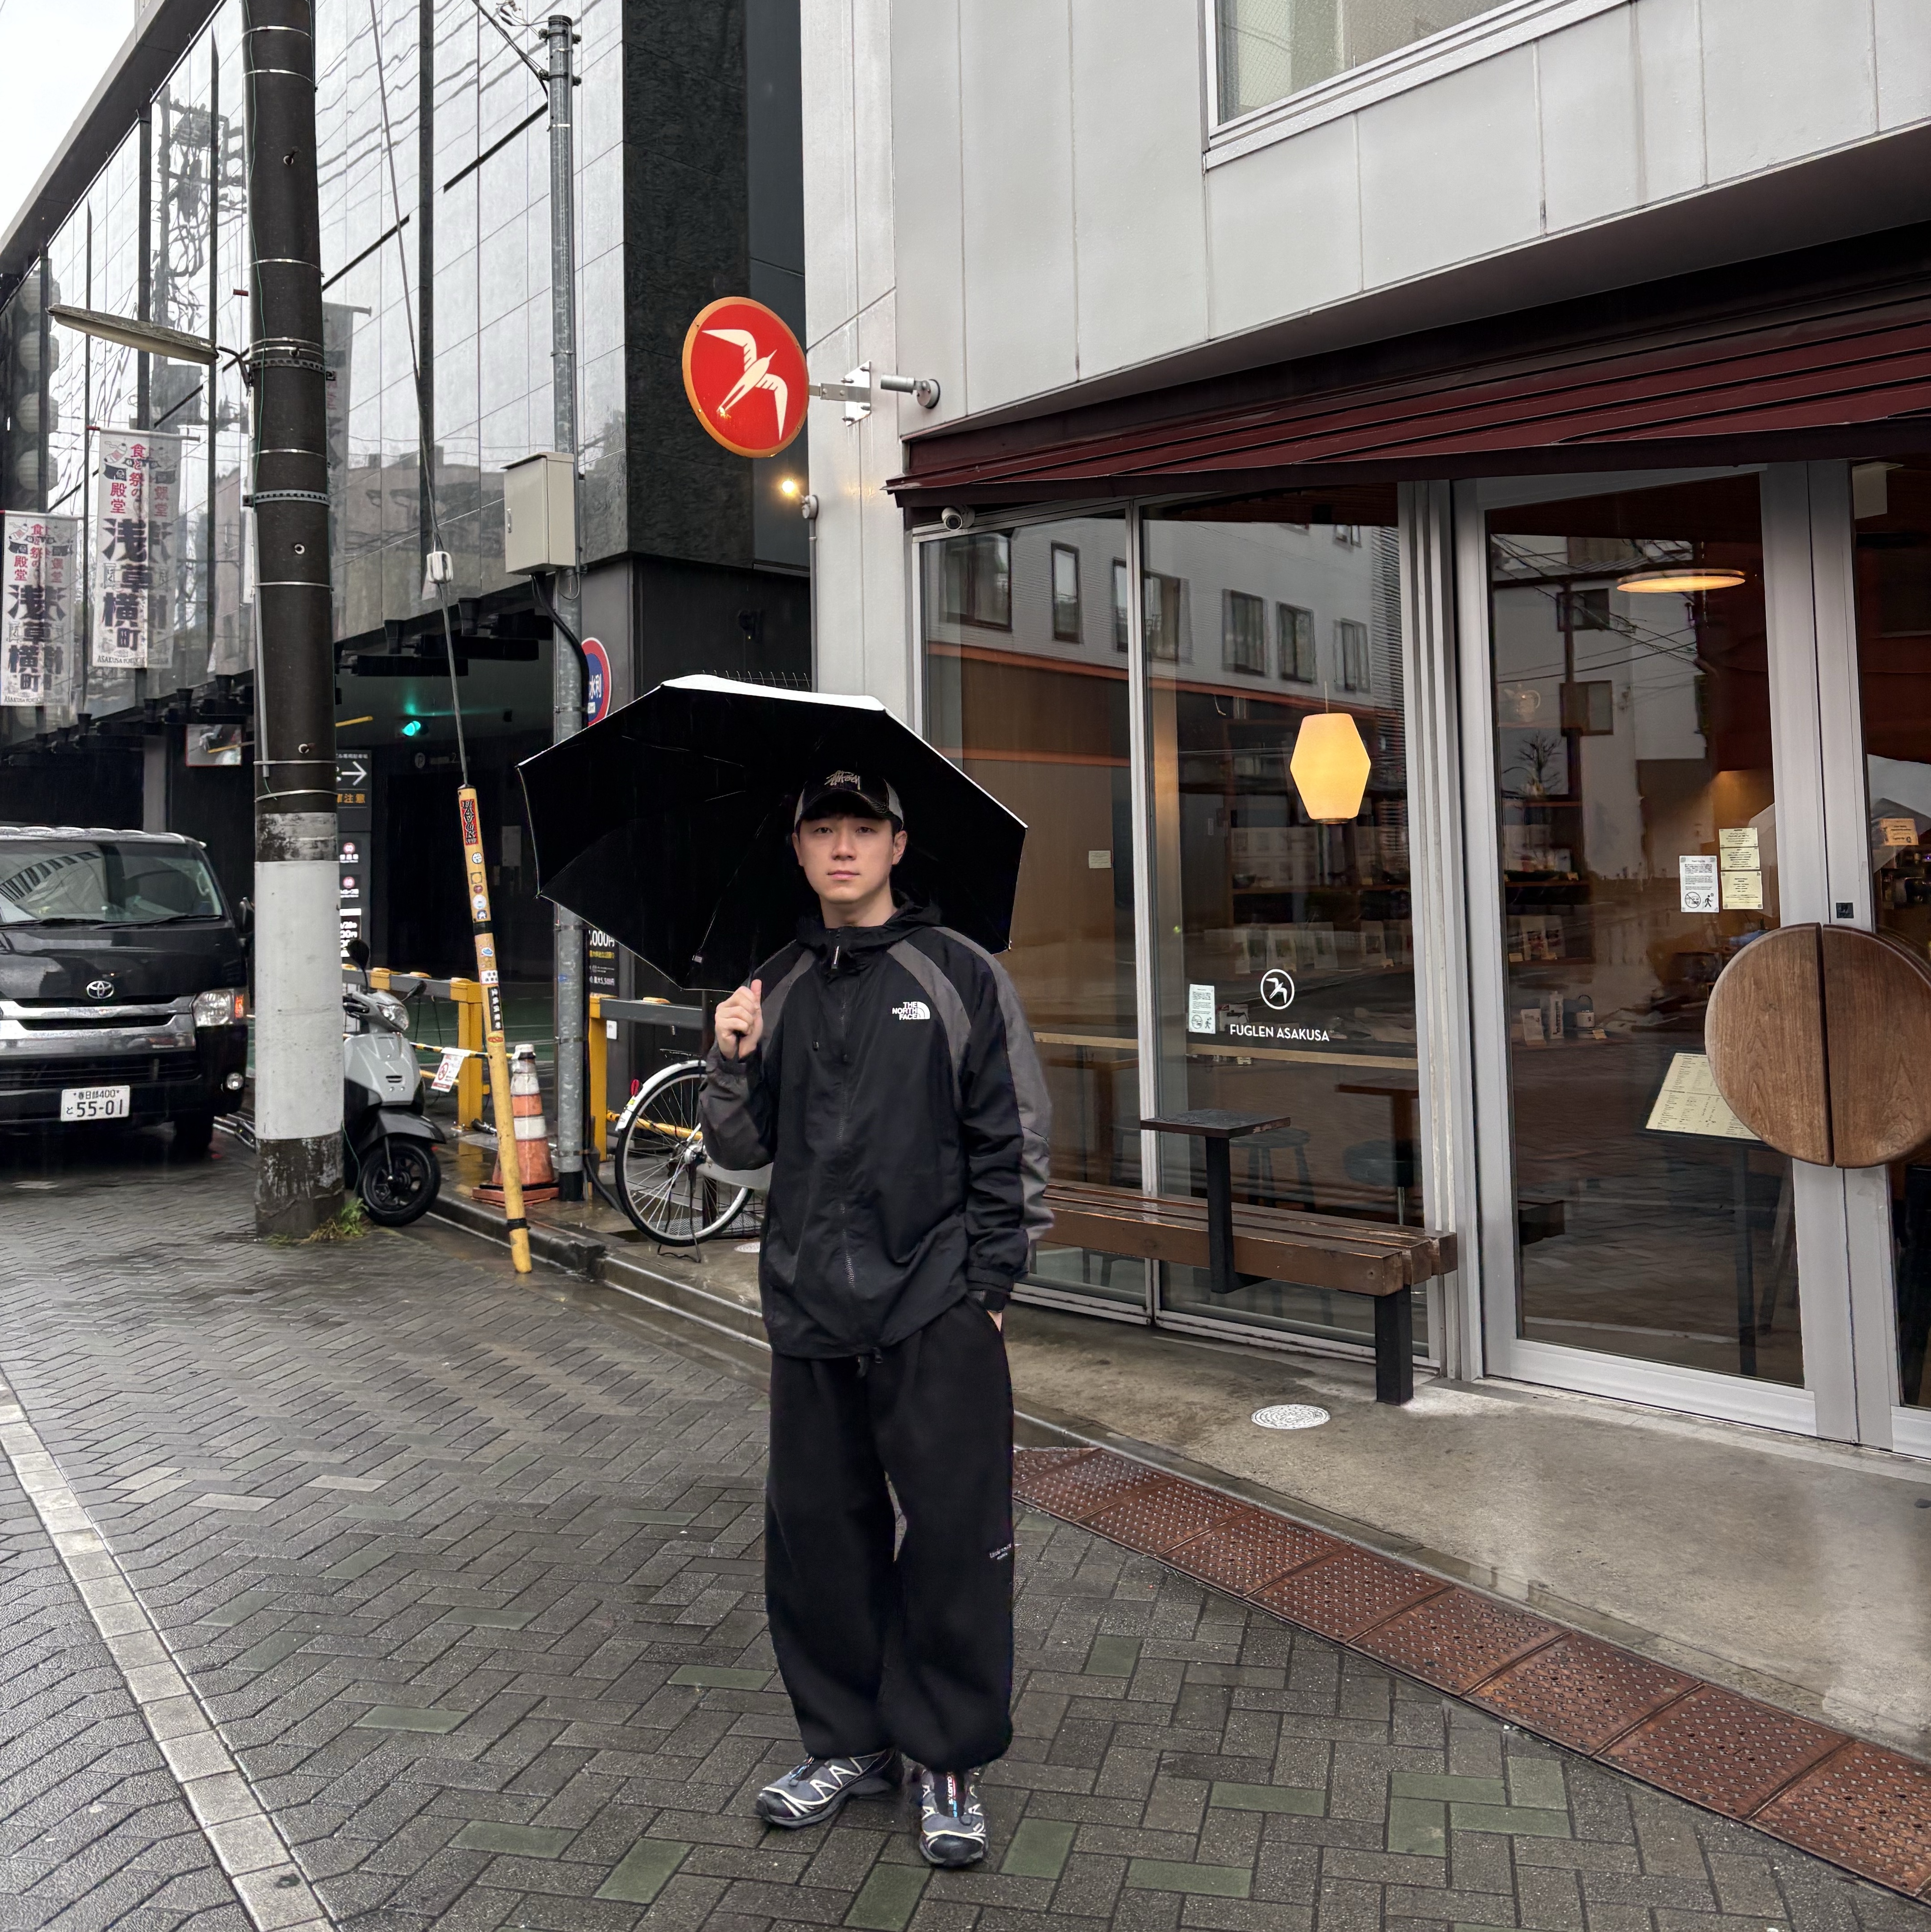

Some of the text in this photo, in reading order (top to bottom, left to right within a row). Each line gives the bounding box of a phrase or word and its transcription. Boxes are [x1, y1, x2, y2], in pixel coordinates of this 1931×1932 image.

[110, 482, 127, 514] 殿堂
[14, 555, 28, 581] 殿堂
[101, 518, 151, 651] 浅草横町
[1230, 1024, 1330, 1042] FUGLEN ASAKUSA
[66, 1099, 123, 1117] と 55-01
